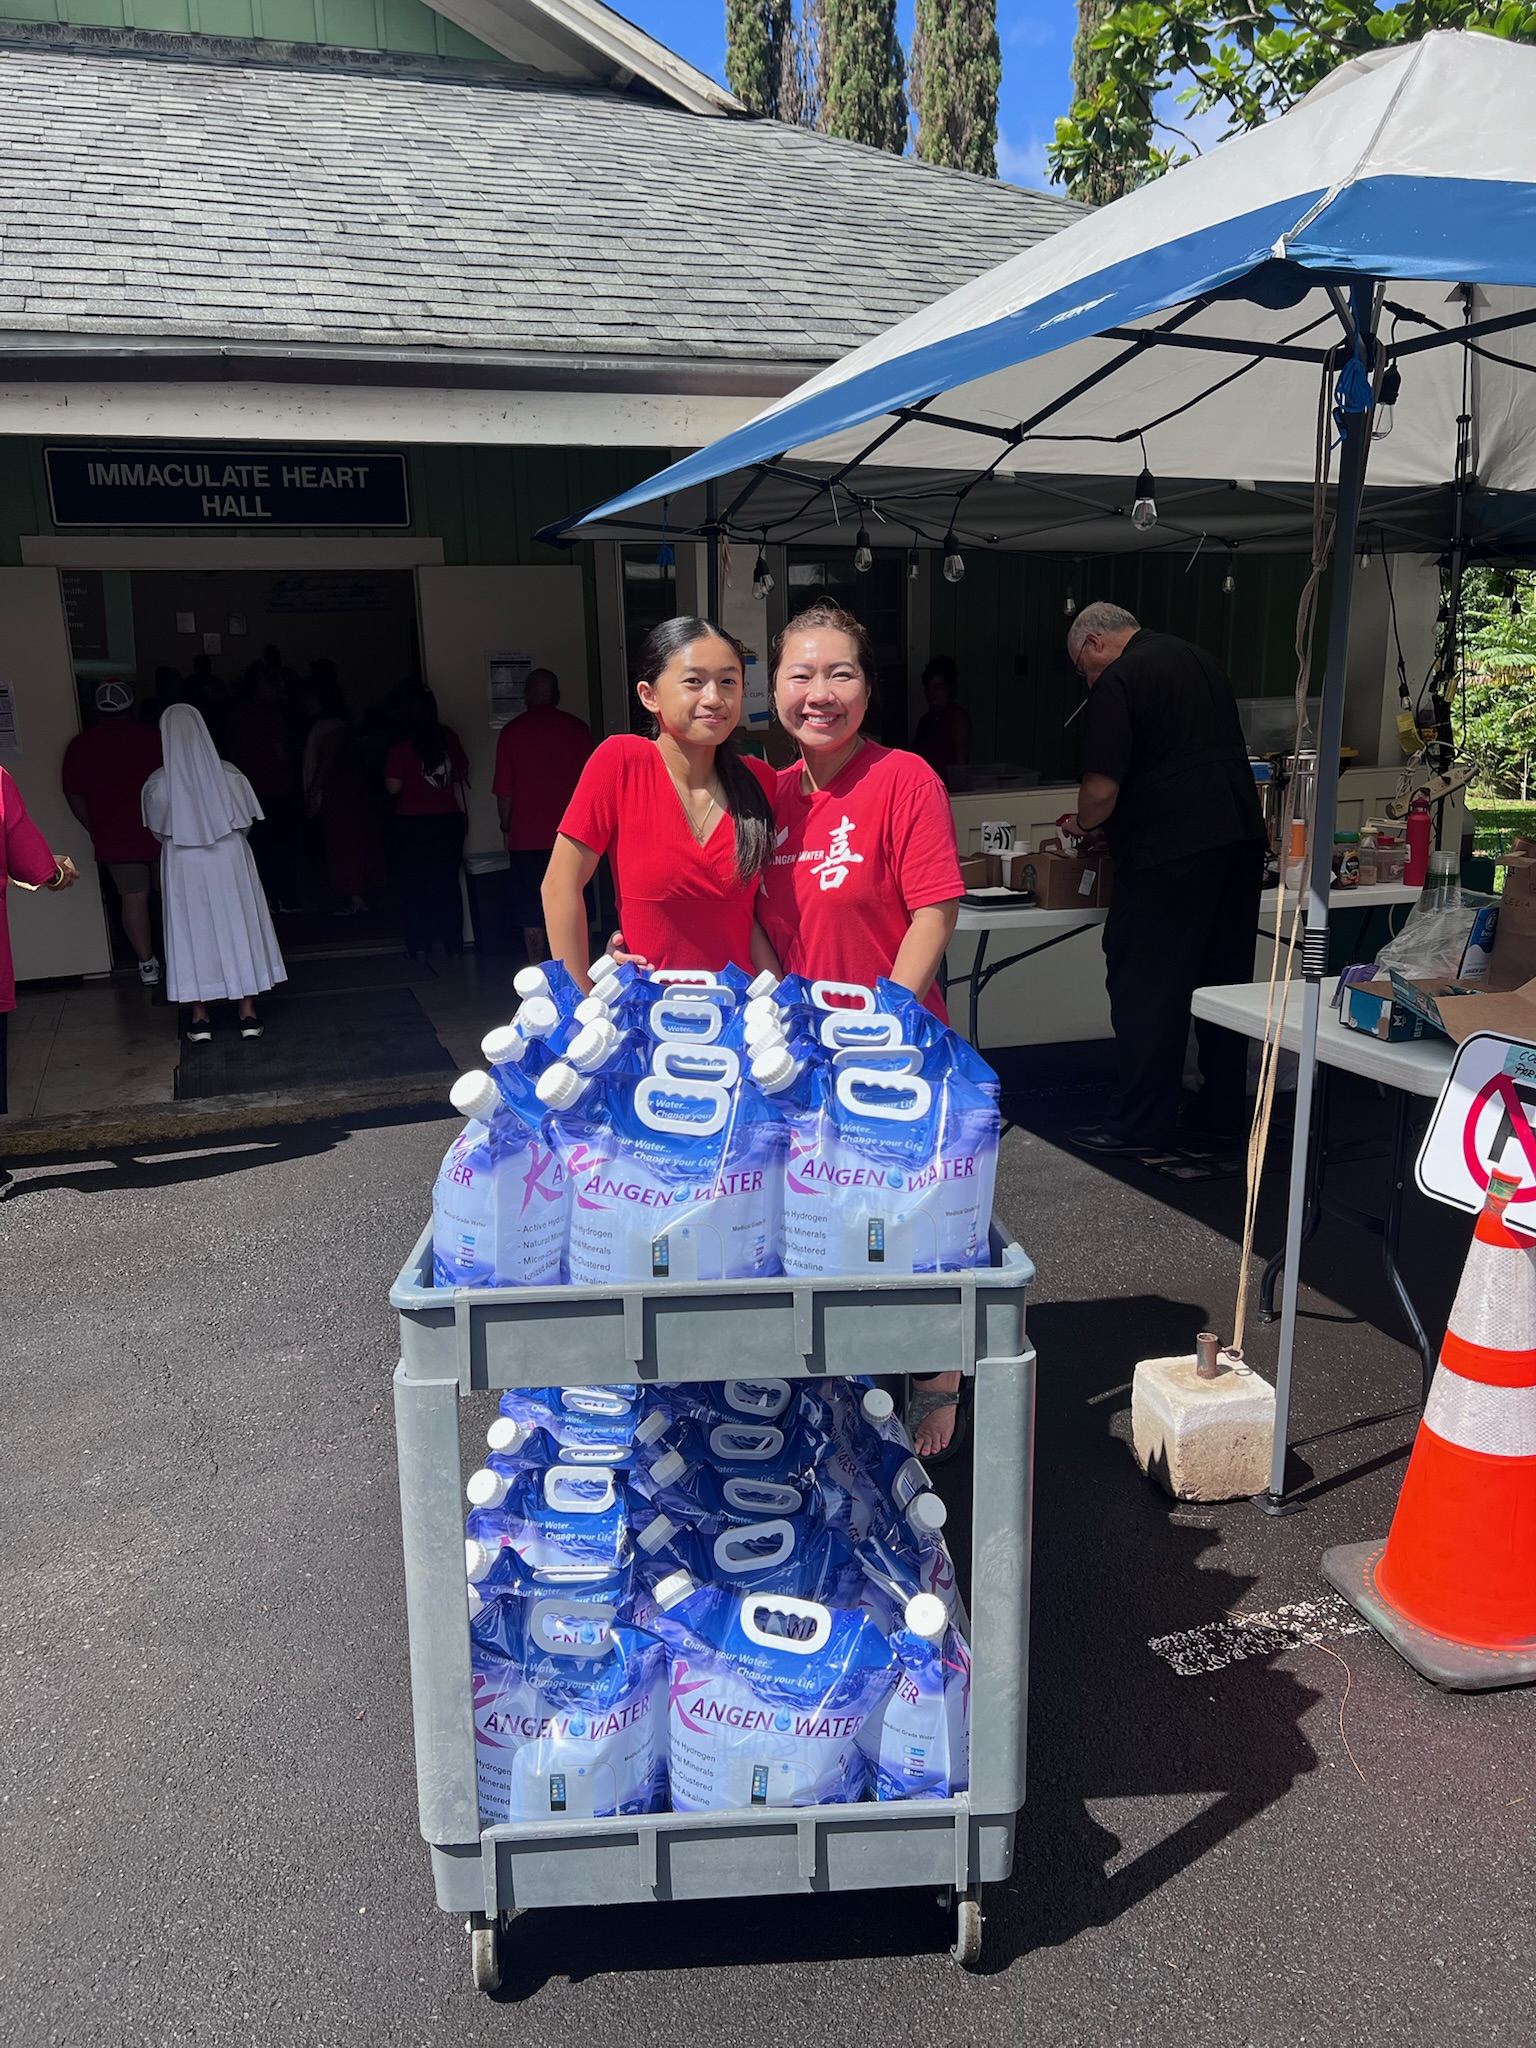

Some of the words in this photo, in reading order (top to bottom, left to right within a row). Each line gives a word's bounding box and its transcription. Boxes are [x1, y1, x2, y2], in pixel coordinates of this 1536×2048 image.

[87, 463, 271, 488] IMMACULATE
[281, 466, 370, 489] HEART
[202, 495, 272, 518] HALL
[798, 850, 825, 862] WATER
[810, 815, 864, 891] 喜
[1413, 1015, 1423, 1038] BETT
[840, 1124, 876, 1135] Water...
[634, 1140, 672, 1153] Water...
[840, 1134, 877, 1145] Change
[879, 1138, 901, 1147] your
[904, 1139, 923, 1152] Life
[633, 1151, 666, 1165] Change
[673, 1158, 697, 1168] your
[698, 1156, 717, 1167] Life
[907, 1156, 976, 1192] WATER
[791, 1210, 828, 1223] Hydrogen
[579, 1226, 613, 1239] Hydrogen
[794, 1227, 827, 1239] Minerals
[523, 1235, 550, 1249] Natural
[793, 1260, 824, 1272] Alkaline
[564, 1425, 593, 1434] Change
[611, 1426, 625, 1434] Life
[545, 1521, 575, 1530] Water...
[545, 1532, 576, 1541] Change
[577, 1533, 595, 1542] your
[597, 1532, 612, 1542] Life
[533, 1587, 567, 1596] Water...
[592, 1593, 609, 1603] Life
[682, 1637, 715, 1656] Change
[715, 1650, 737, 1661] your
[738, 1654, 773, 1670] Water...
[737, 1667, 772, 1683] Change
[774, 1675, 796, 1686] your
[797, 1677, 815, 1689] Life
[590, 1681, 609, 1692] Life
[795, 1715, 863, 1738] WATER
[901, 1729, 918, 1739] Grade
[681, 1742, 716, 1763] Hydrogen
[477, 1758, 511, 1776] Hydrogen
[683, 1758, 714, 1777] Minerals
[479, 1775, 511, 1790] Minerals
[681, 1788, 710, 1806] Alkaline
[479, 1805, 508, 1820] Alkaline
